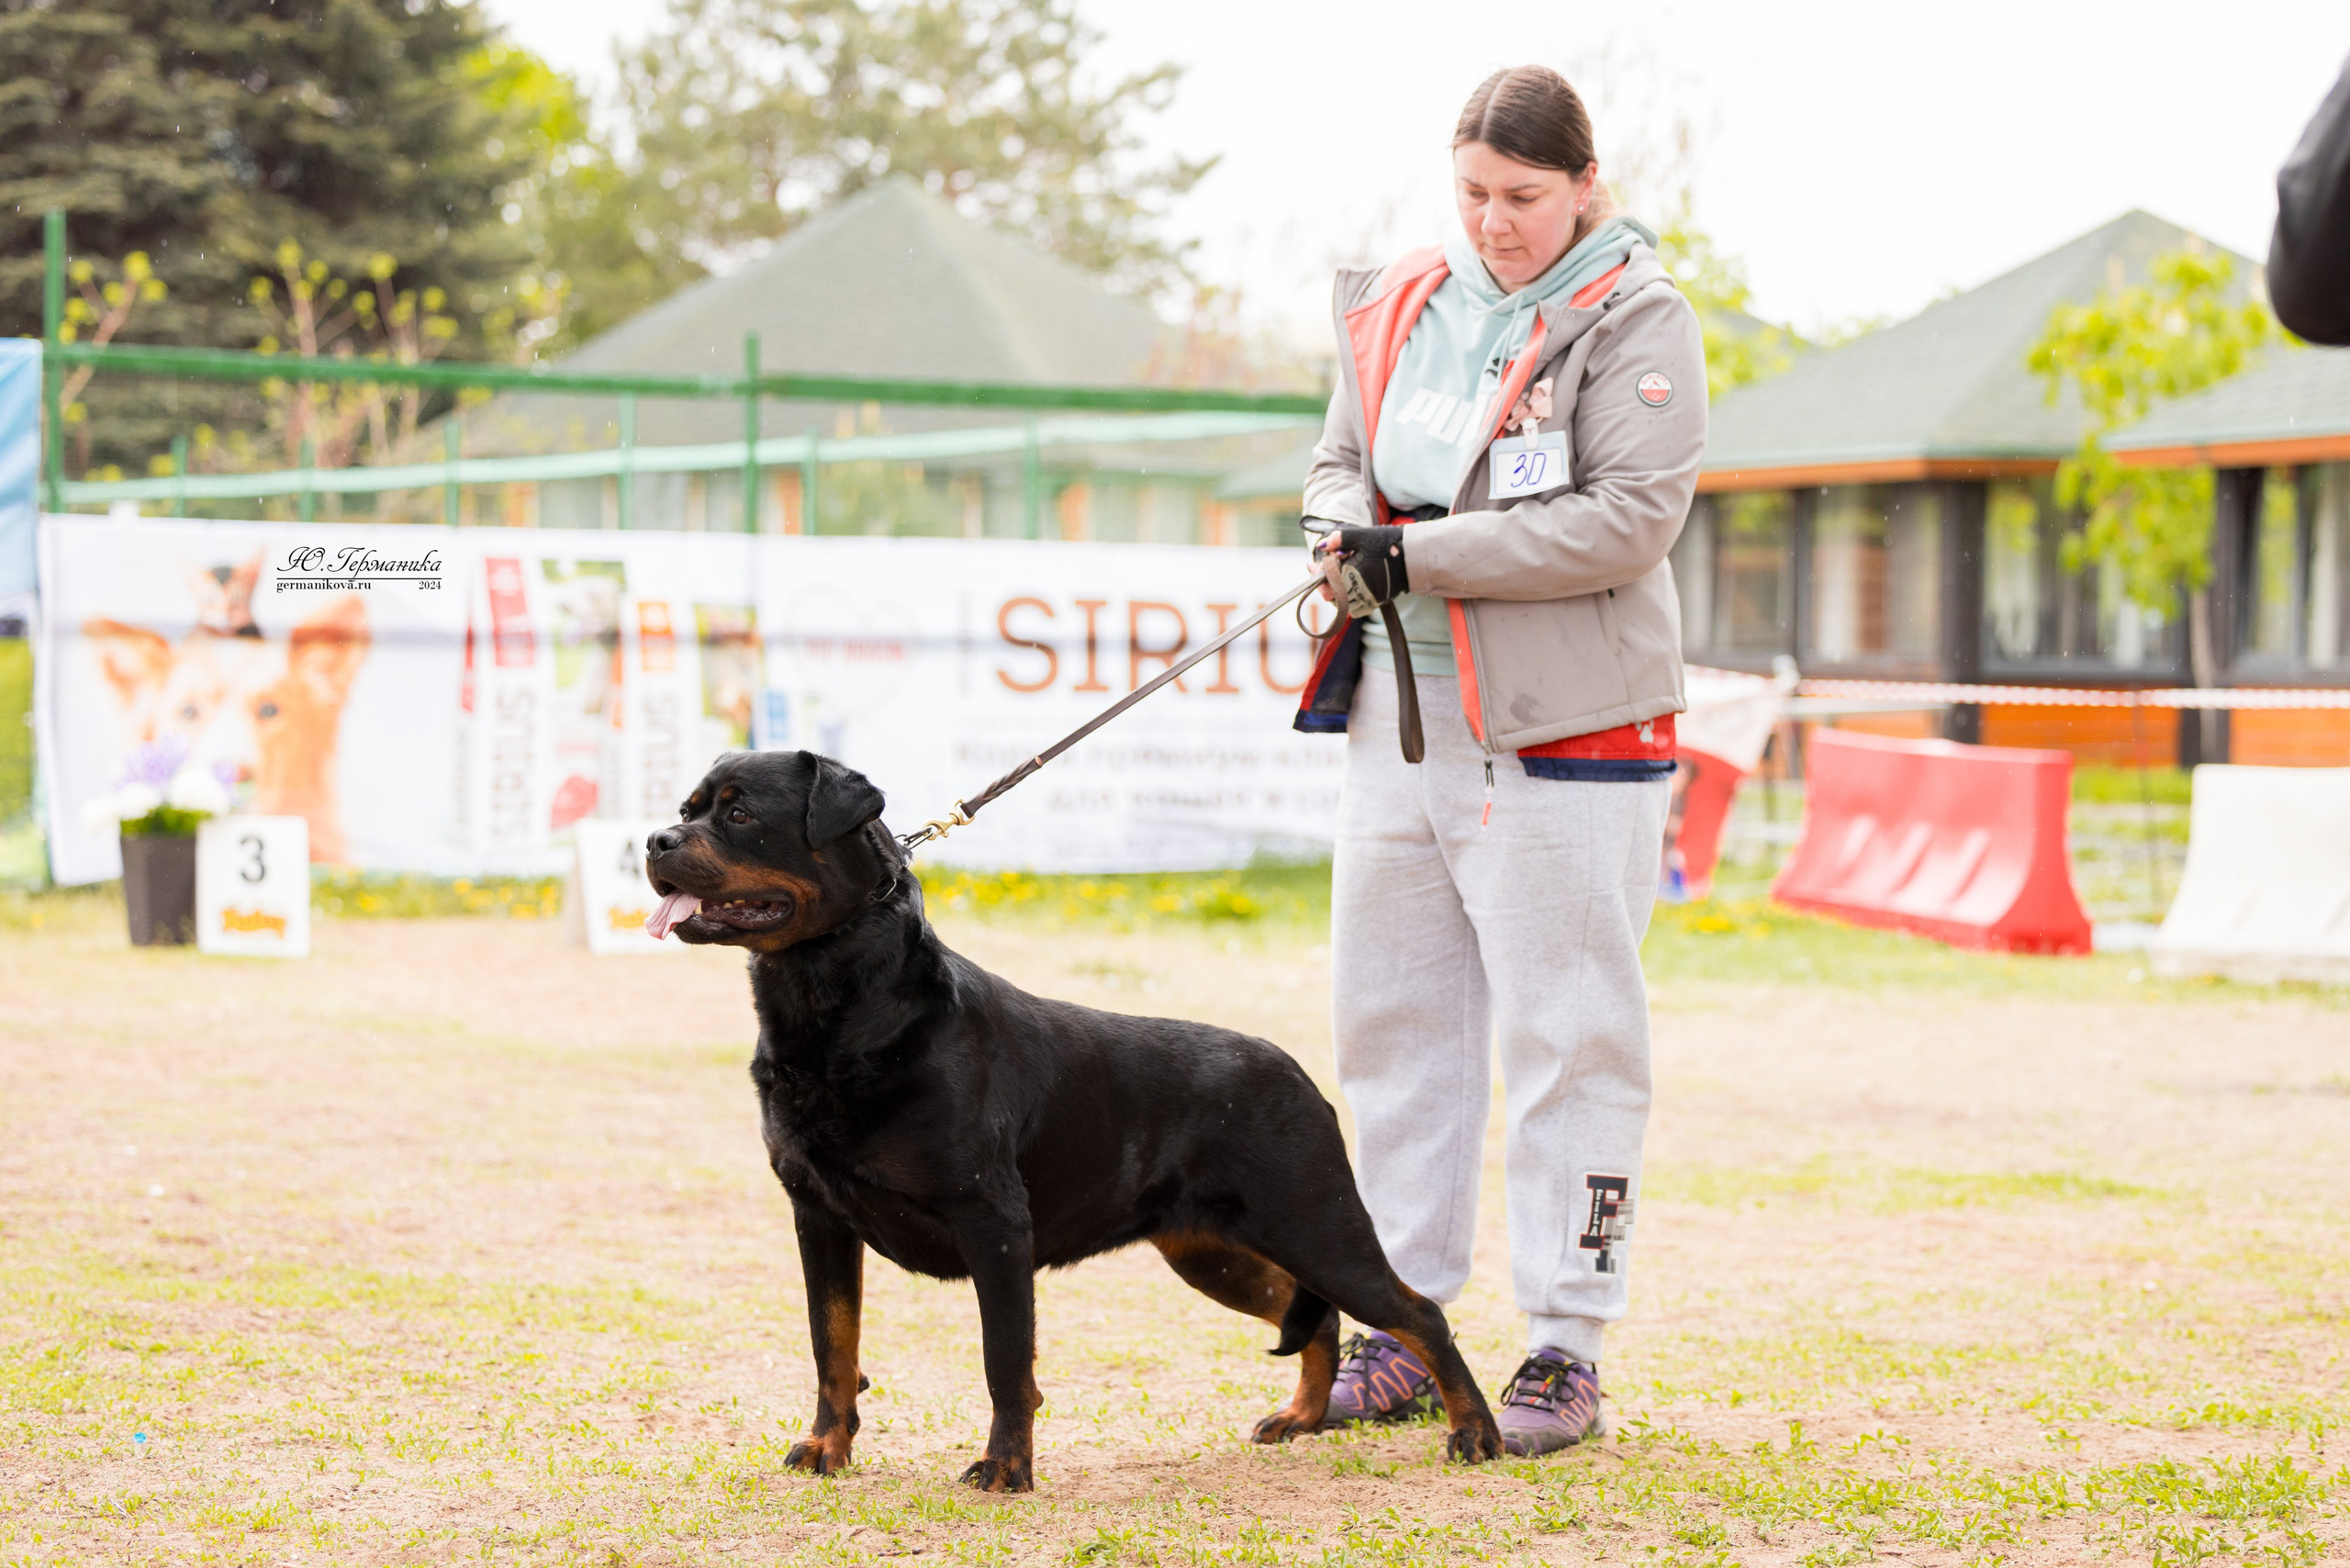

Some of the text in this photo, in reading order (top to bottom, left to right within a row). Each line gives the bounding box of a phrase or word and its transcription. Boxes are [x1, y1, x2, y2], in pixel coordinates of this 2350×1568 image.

[1511, 453, 1547, 487] 30
[997, 598, 1318, 694] SIRIU
[240, 835, 265, 883] 3
[618, 837, 641, 881] 4
[1589, 1188, 1605, 1238] FILA
